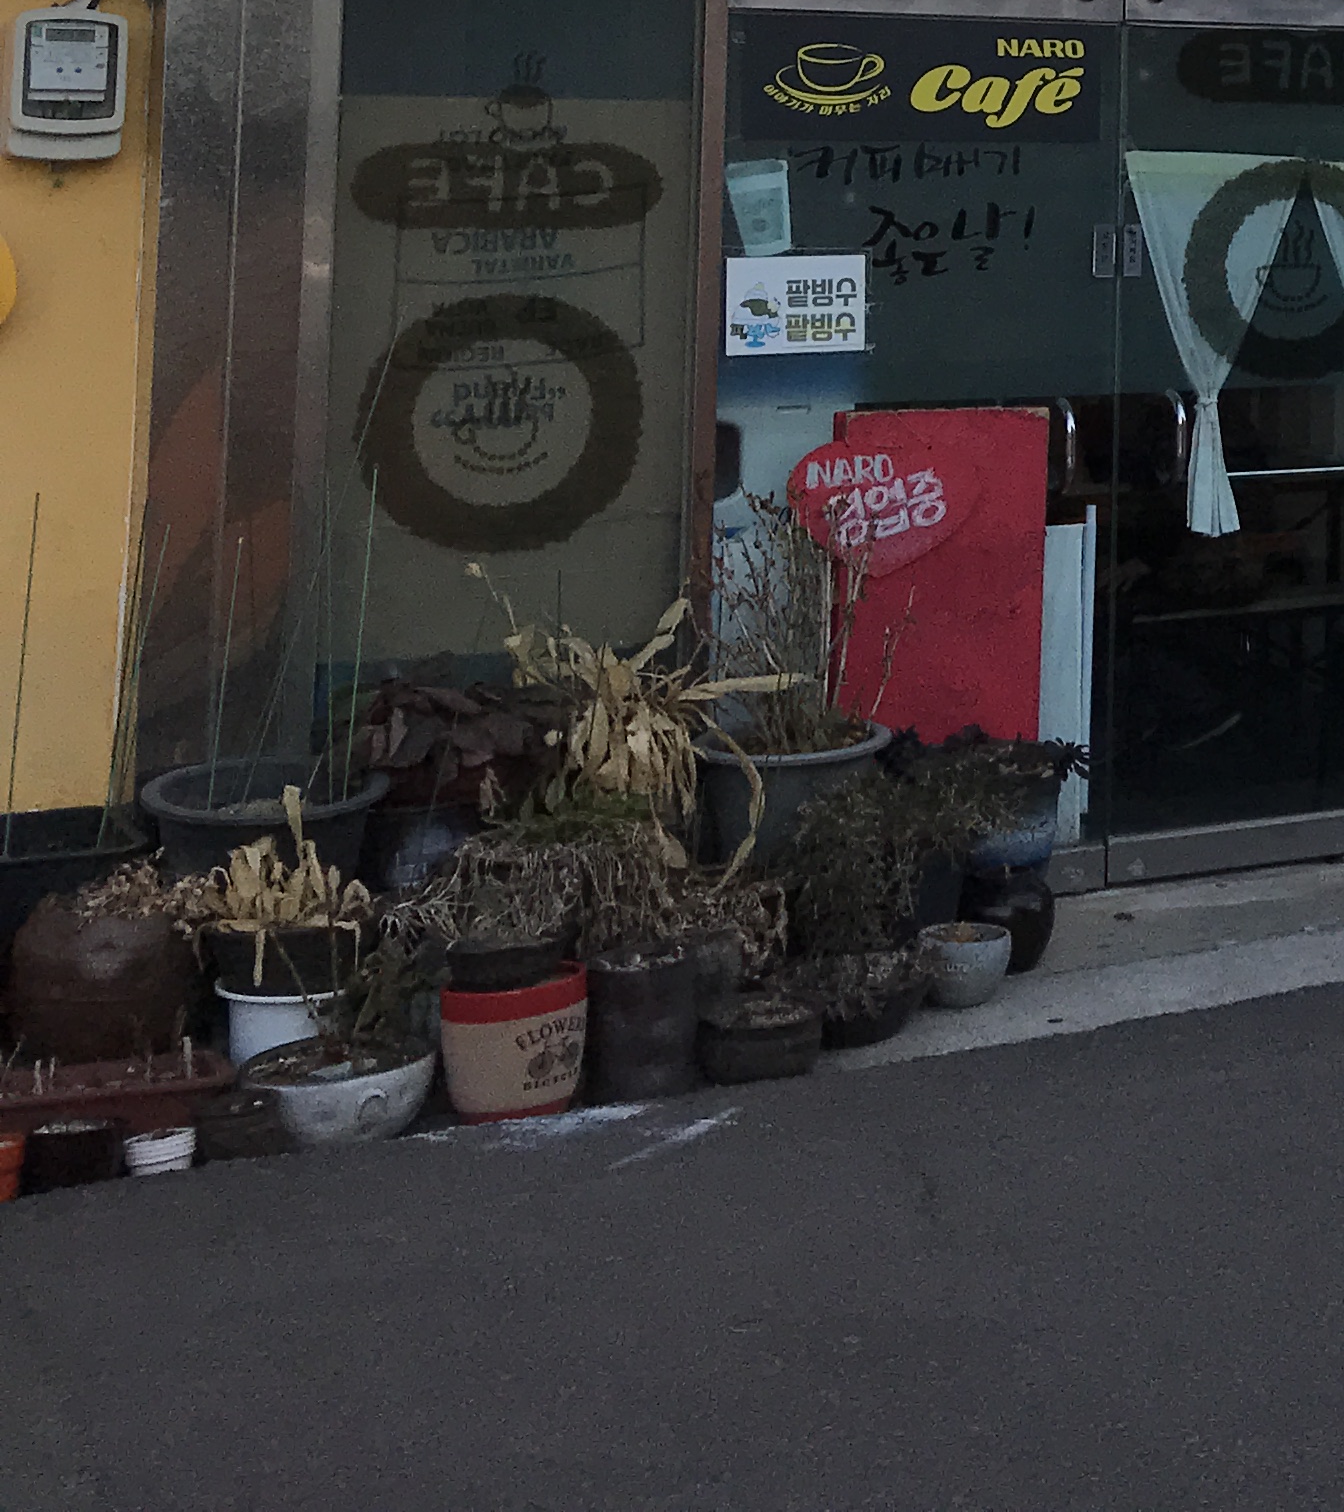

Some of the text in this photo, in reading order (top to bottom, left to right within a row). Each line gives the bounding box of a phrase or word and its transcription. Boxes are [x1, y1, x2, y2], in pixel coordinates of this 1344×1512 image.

[997, 38, 1085, 59] NARO
[909, 63, 1086, 130] Café
[789, 143, 903, 186] 커피
[786, 276, 858, 308] 팥빙수
[785, 311, 857, 342] 팥빙수
[806, 453, 894, 490] NARO
